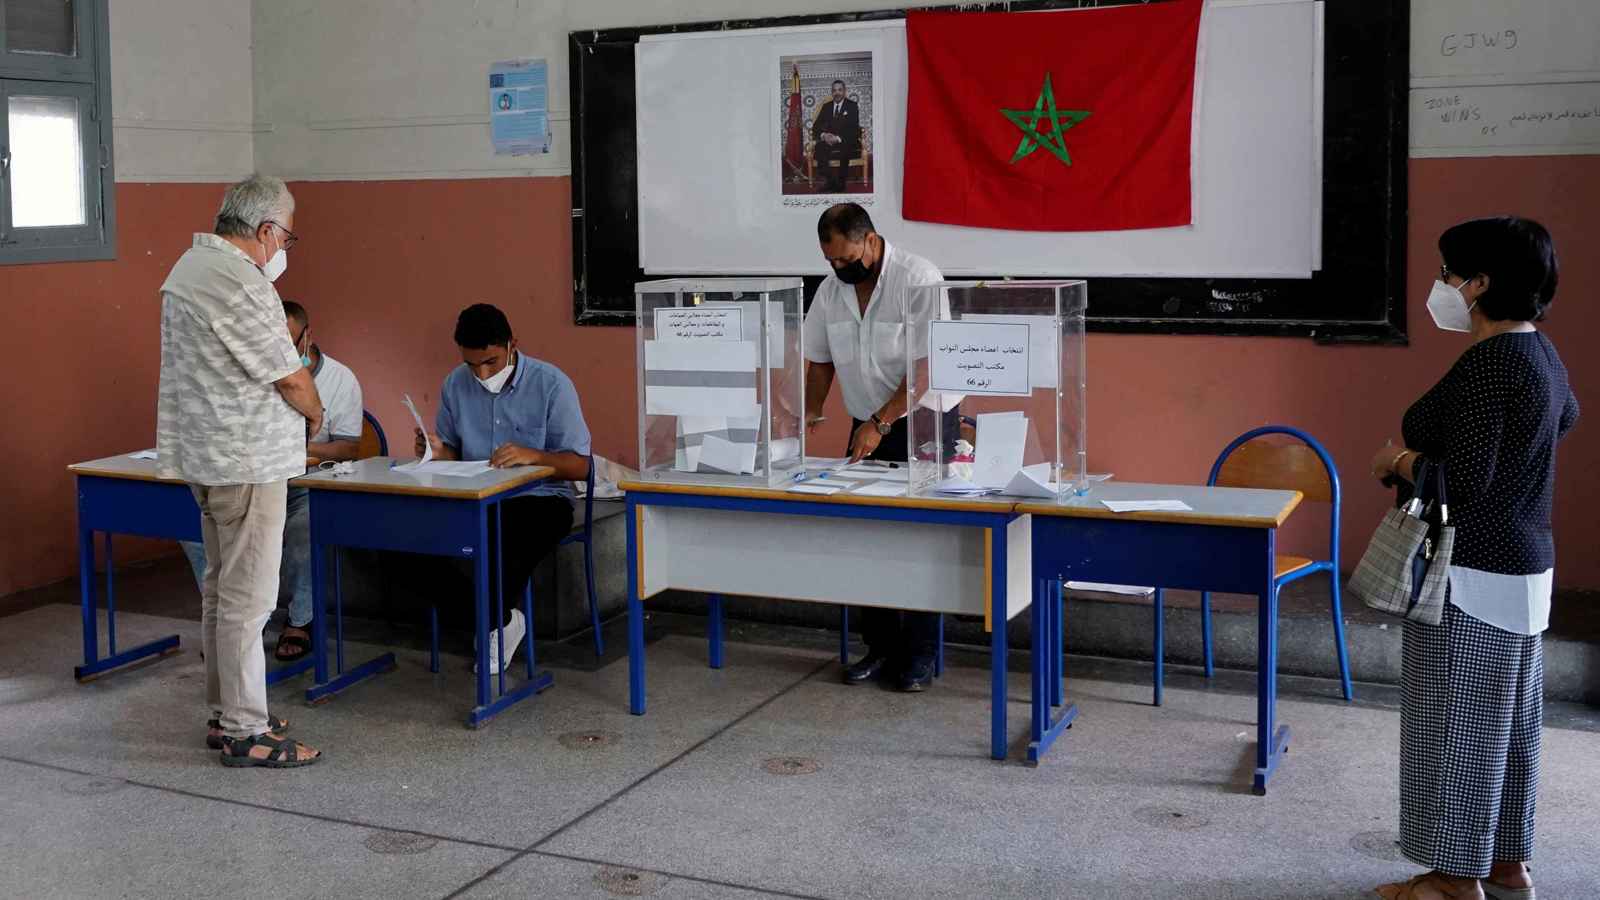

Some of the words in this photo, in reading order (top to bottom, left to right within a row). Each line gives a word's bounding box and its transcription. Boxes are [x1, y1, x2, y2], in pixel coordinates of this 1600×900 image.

[938, 343, 959, 354] النواب
[959, 344, 980, 354] مجلس
[1002, 345, 1024, 354] انتخاب
[956, 361, 984, 371] التصويت
[985, 362, 1006, 371] مكتب
[966, 377, 976, 386] 66
[976, 377, 992, 388] الرقم
